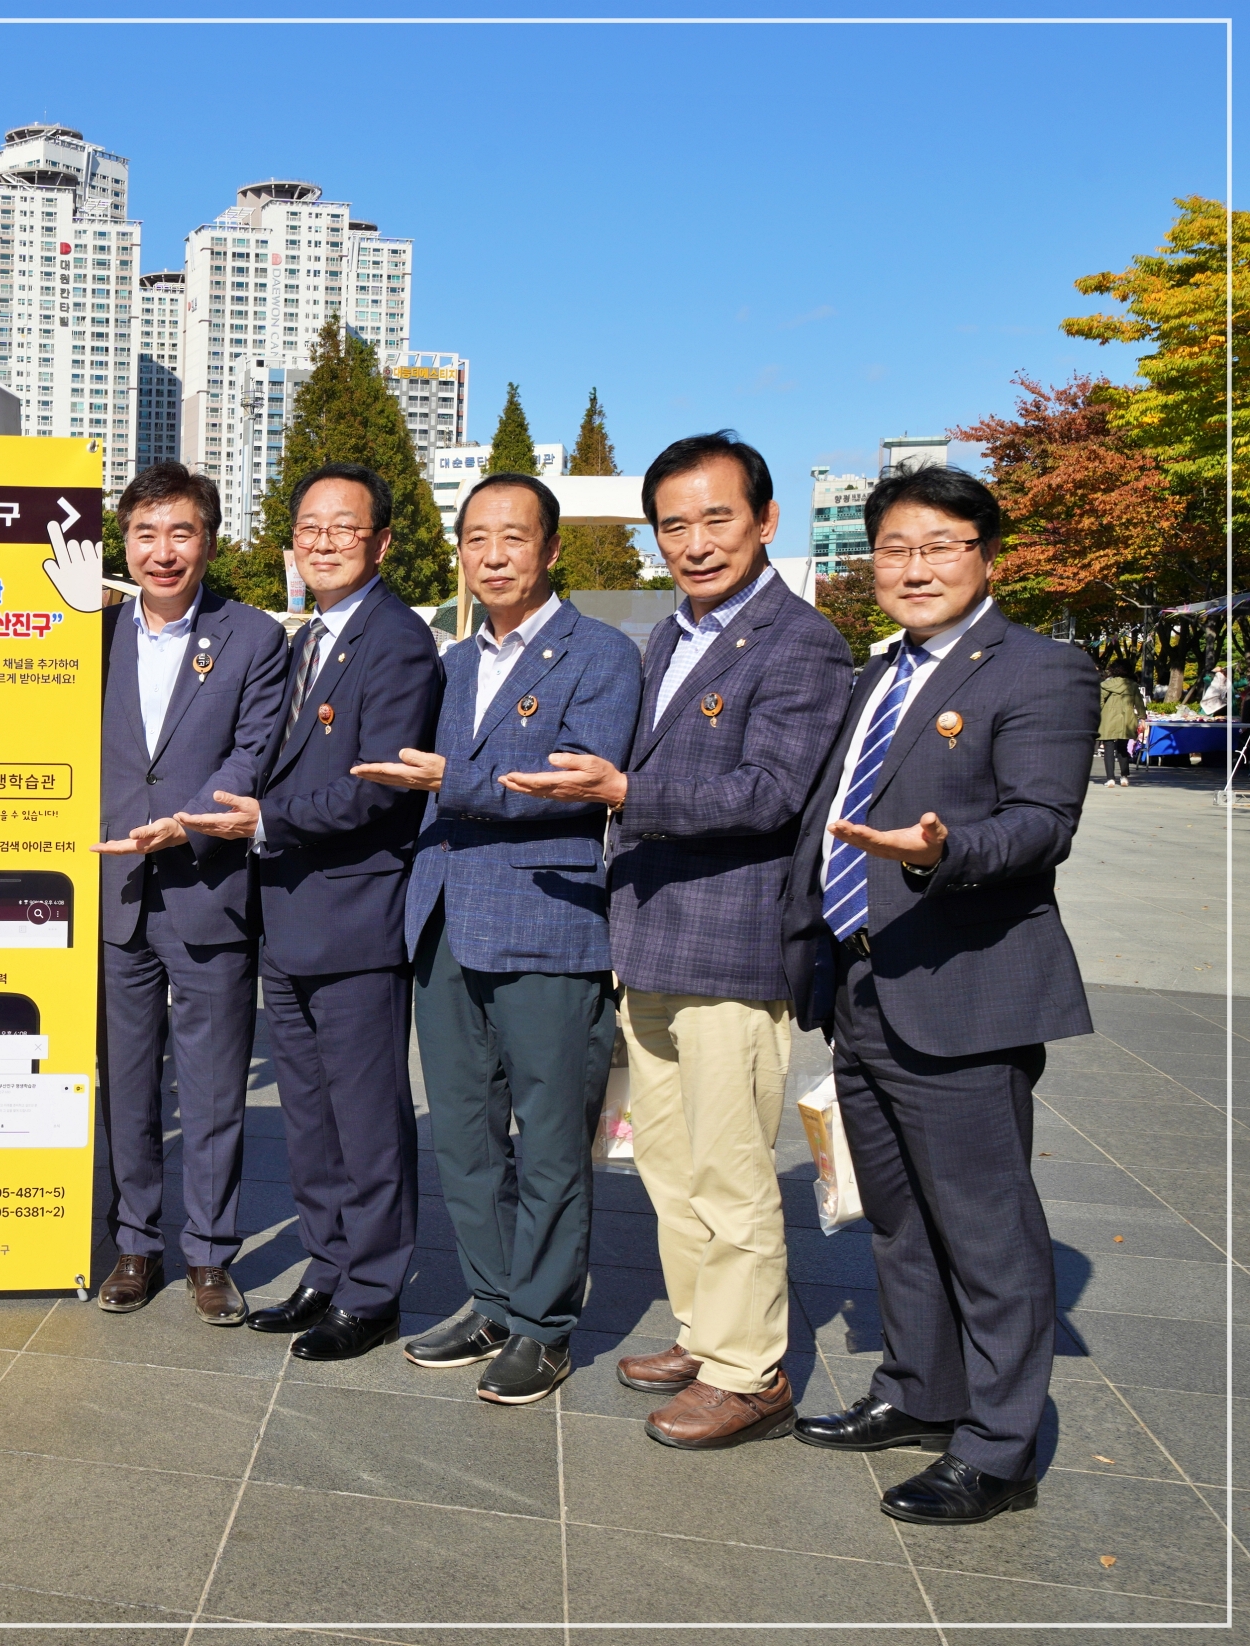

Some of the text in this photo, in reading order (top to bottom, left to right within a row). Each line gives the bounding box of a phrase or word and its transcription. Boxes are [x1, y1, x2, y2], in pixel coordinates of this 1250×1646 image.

[271, 268, 281, 328] DAEWON
[3, 658, 35, 670] 채널을
[37, 658, 79, 670] 추가하여
[19, 673, 76, 685] 받아보세요!
[10, 811, 19, 819] 수
[22, 810, 59, 822] 있습니다!
[0, 840, 20, 852] 검색
[22, 840, 53, 852] 아이콘
[55, 841, 76, 852] 터치
